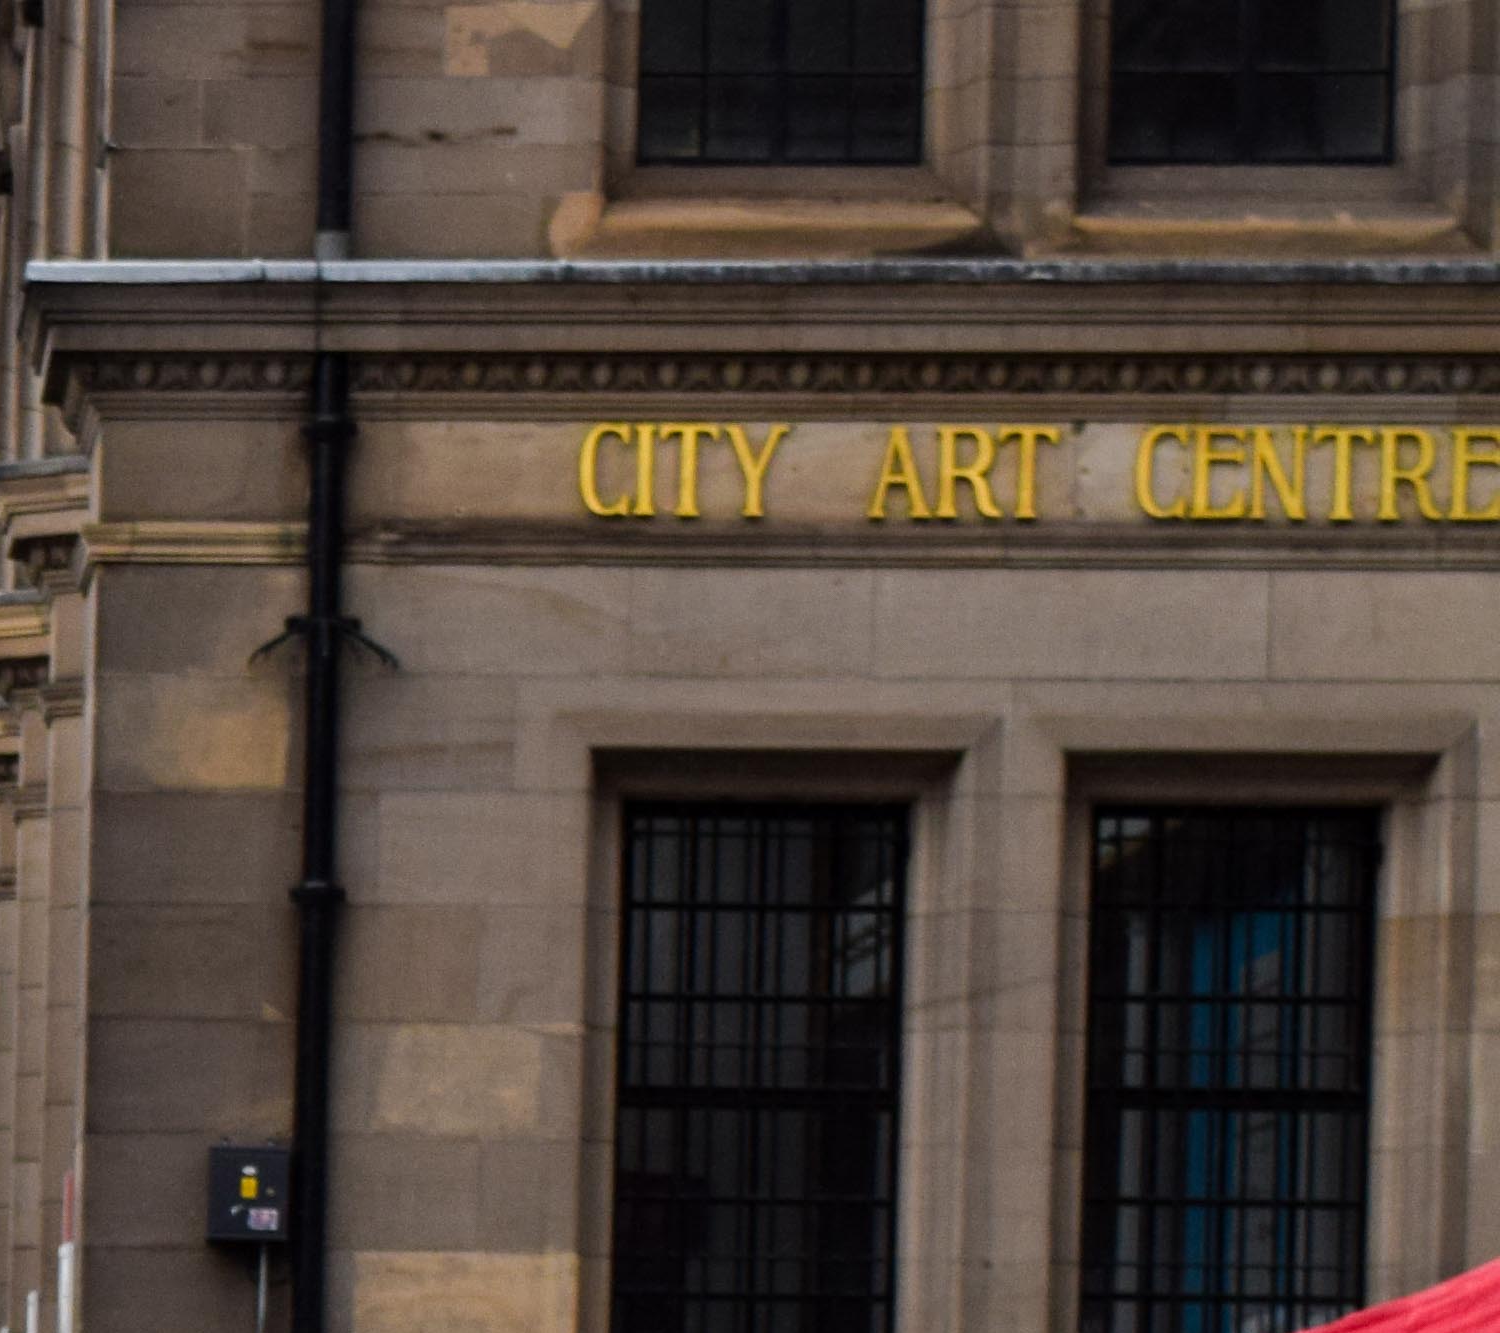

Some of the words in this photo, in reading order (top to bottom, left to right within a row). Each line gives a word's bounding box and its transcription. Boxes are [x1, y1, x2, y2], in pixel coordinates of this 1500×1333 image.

[577, 423, 789, 519] CITY
[868, 424, 1062, 521] ART
[1133, 424, 1500, 522] CENTRE
